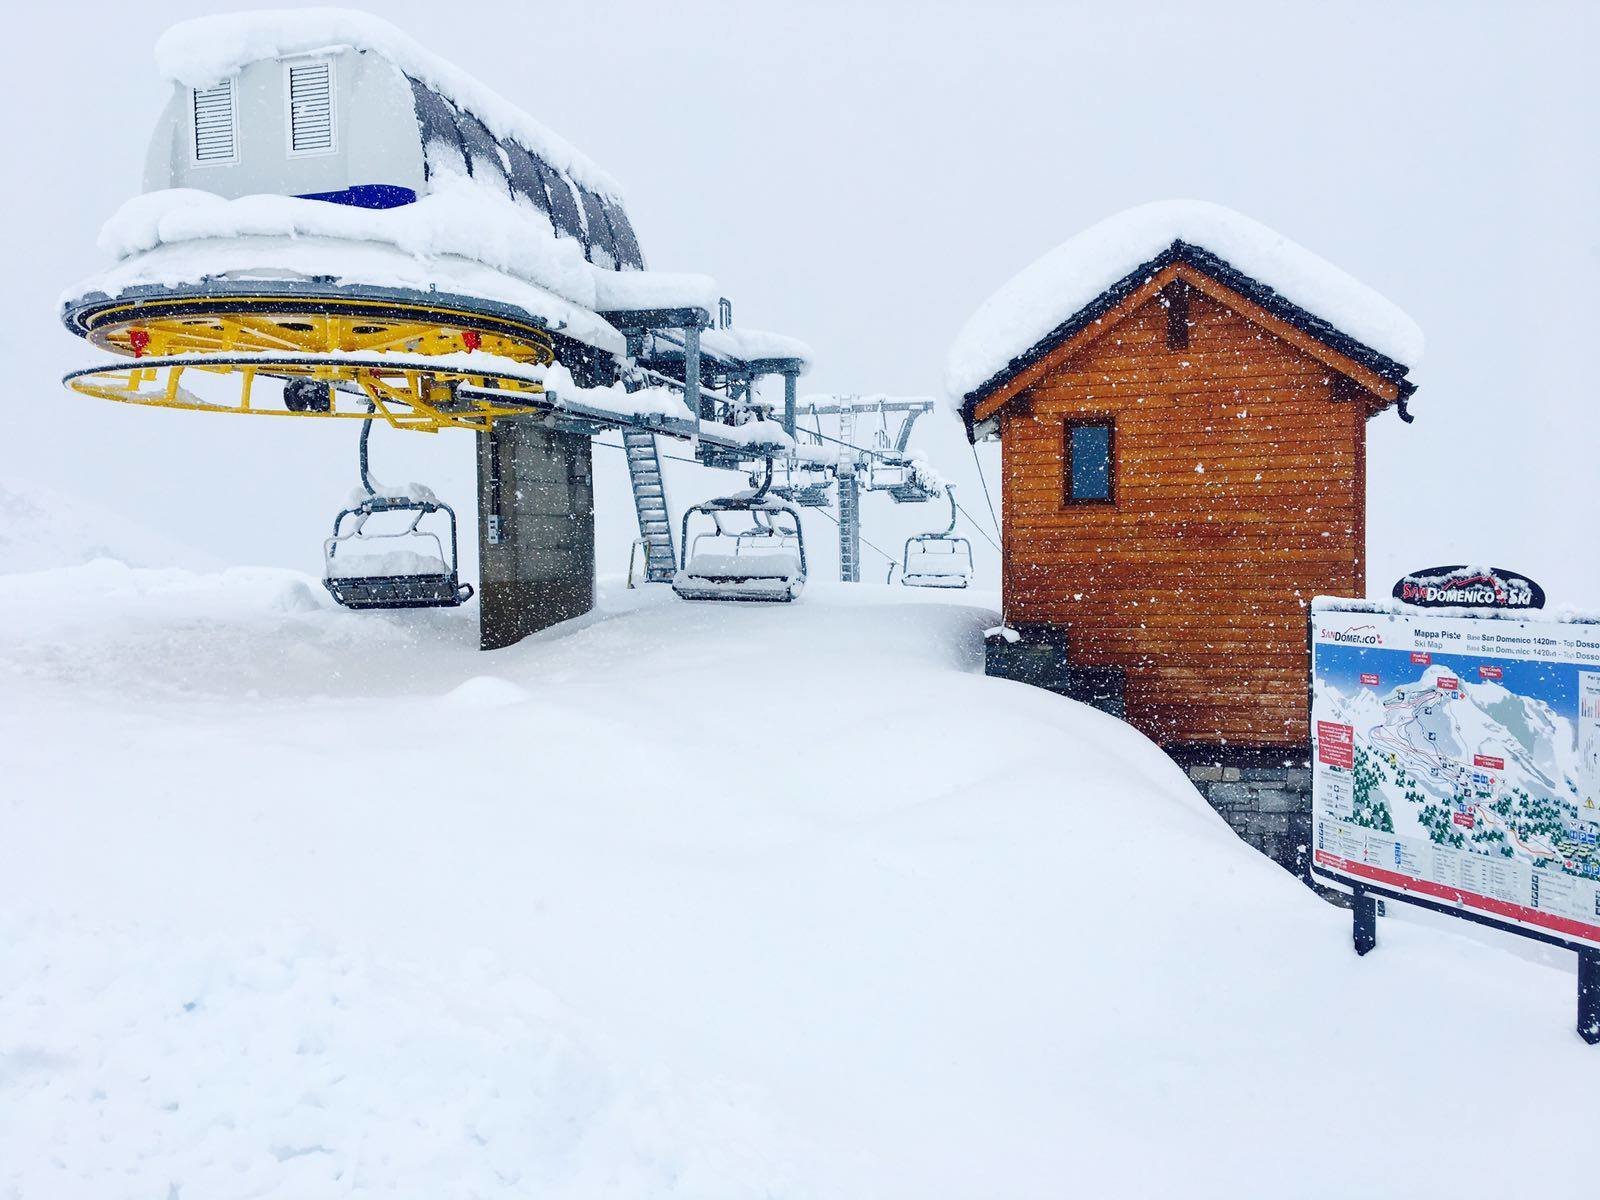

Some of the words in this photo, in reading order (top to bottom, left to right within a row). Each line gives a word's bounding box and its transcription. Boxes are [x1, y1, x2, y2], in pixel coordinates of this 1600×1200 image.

[1414, 629, 1439, 639] Mappa
[1414, 639, 1426, 647] Ski
[1427, 641, 1443, 650] Map
[1481, 634, 1495, 642] San
[1496, 635, 1531, 644] Domenico
[1533, 637, 1557, 646] 1420m
[1563, 639, 1575, 648] Top
[1576, 640, 1600, 649] Dosso
[1481, 645, 1495, 653] San
